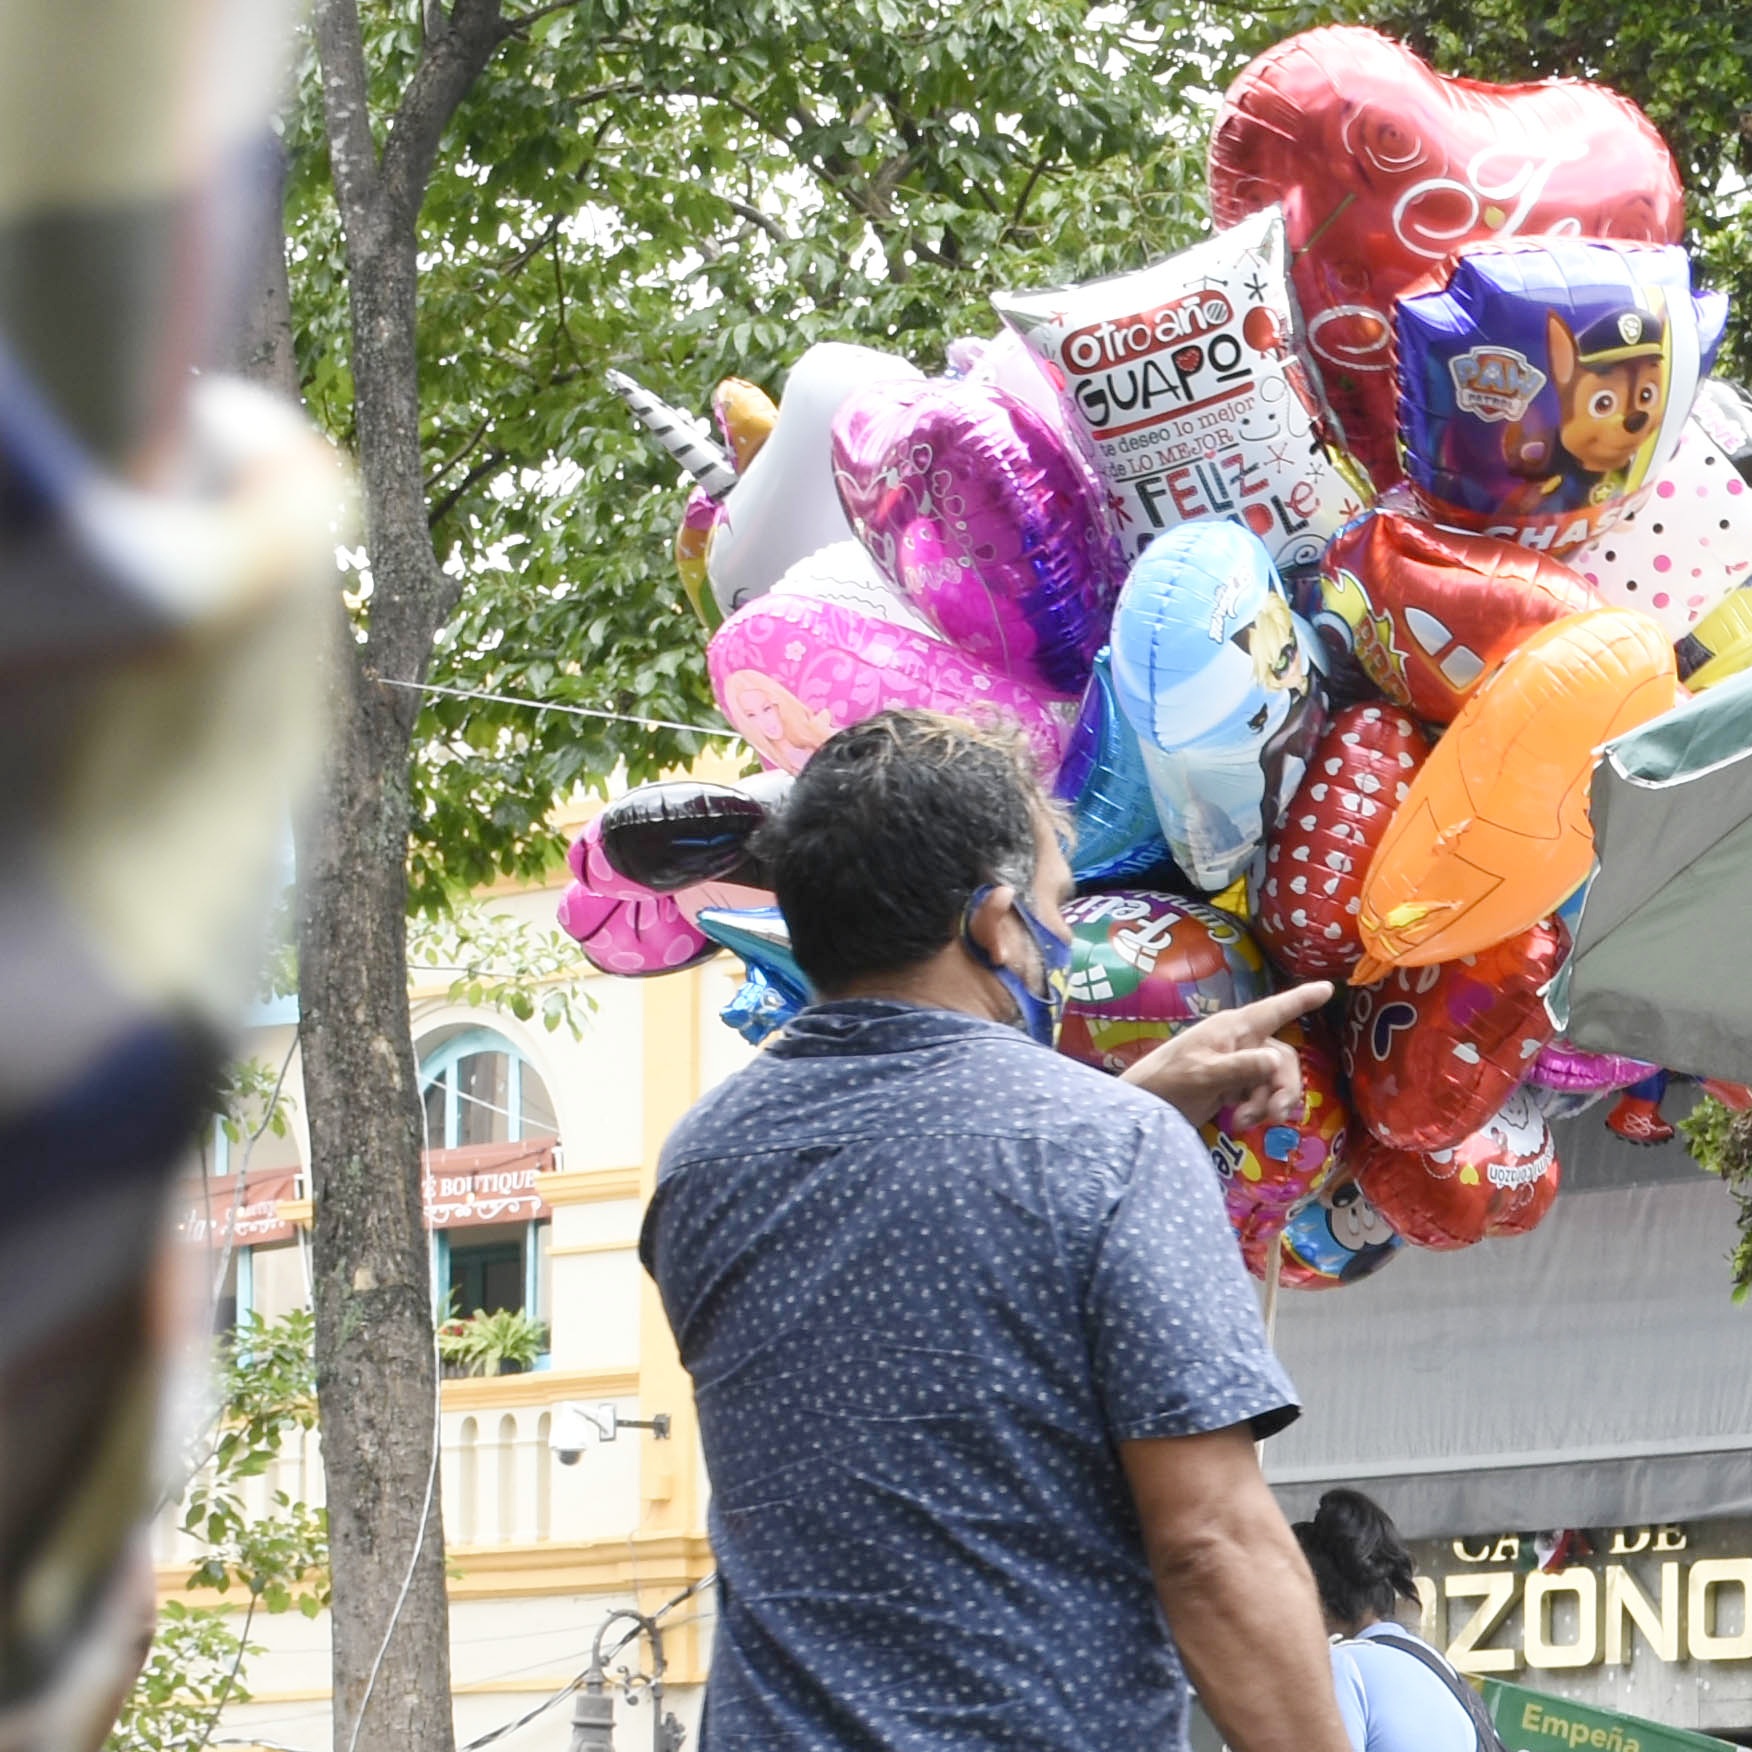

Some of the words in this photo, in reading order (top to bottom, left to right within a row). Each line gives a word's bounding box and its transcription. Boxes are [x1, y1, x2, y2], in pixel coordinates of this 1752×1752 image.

[1154, 298, 1230, 343] año
[1074, 333, 1243, 427] GUAPO
[1454, 357, 1541, 397] PAW
[1100, 440, 1118, 457] te
[1120, 426, 1171, 455] deseo
[1173, 418, 1195, 438] lo
[1199, 394, 1255, 432] mejor
[1129, 450, 1156, 473] LO
[1158, 427, 1235, 465] MEJOR
[439, 1170, 537, 1197] BOUTIQUE
